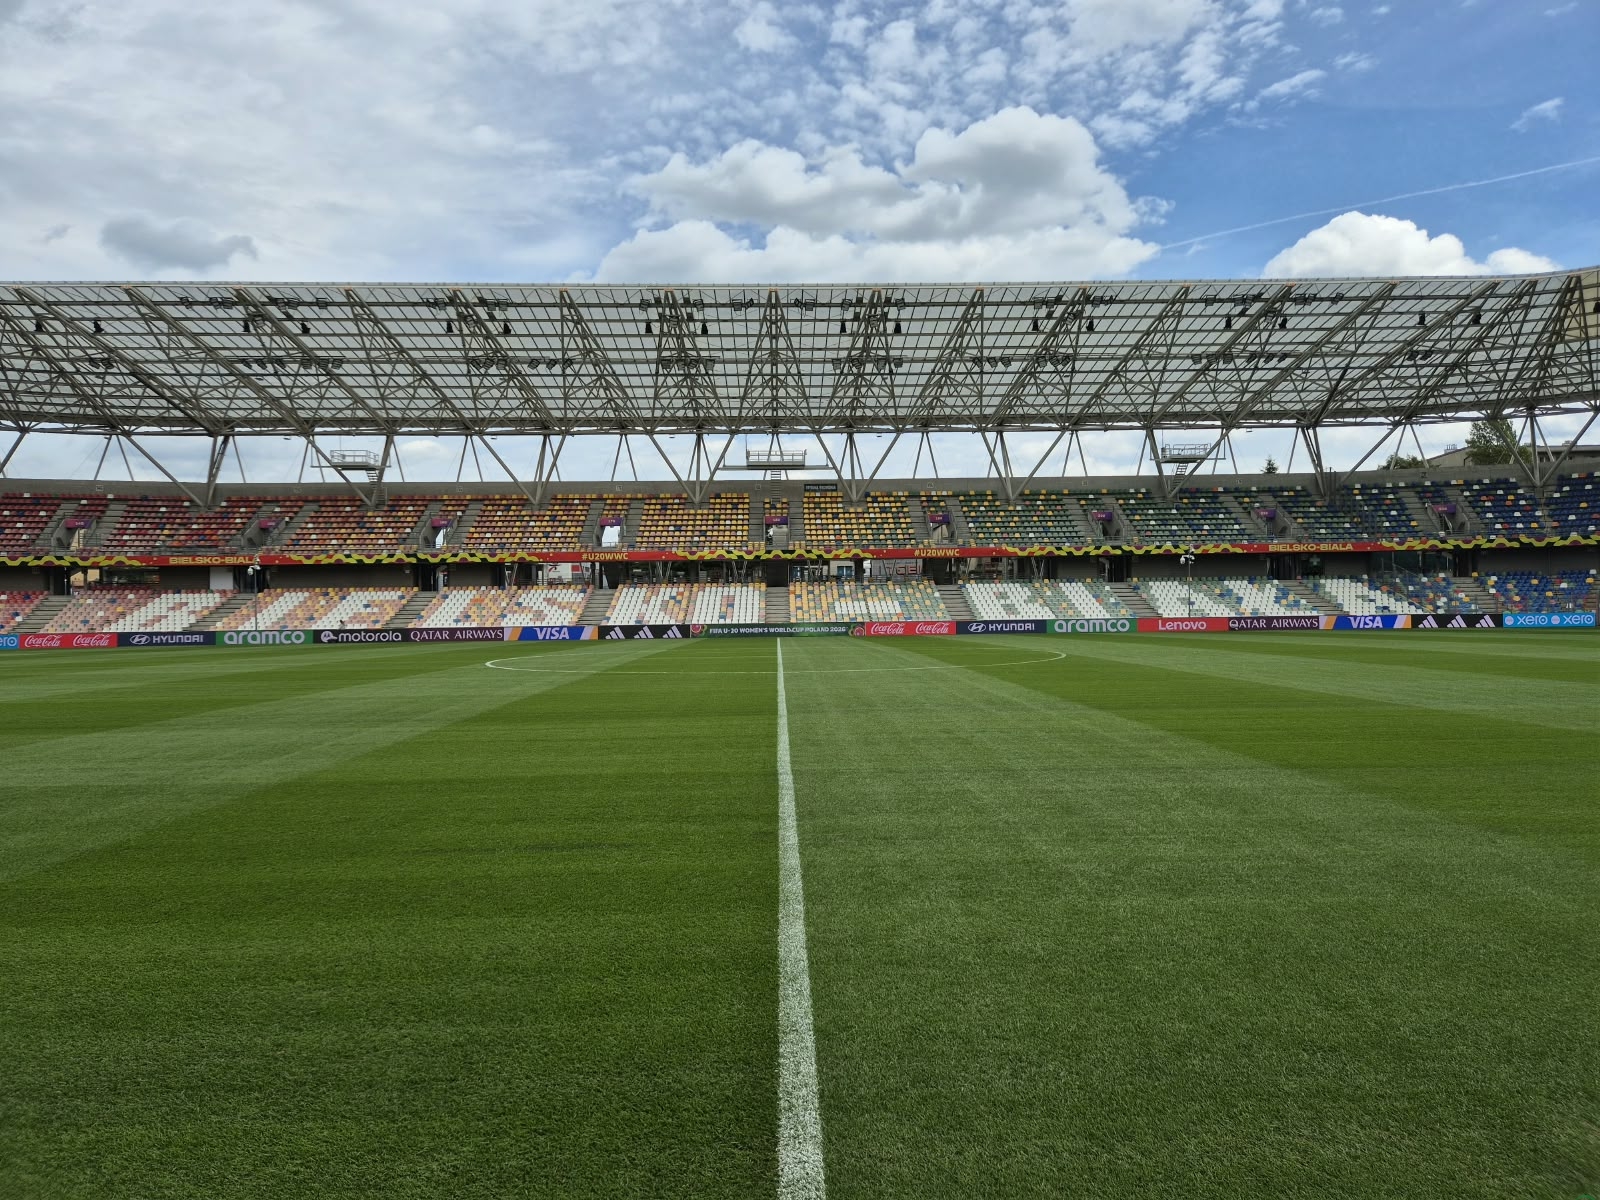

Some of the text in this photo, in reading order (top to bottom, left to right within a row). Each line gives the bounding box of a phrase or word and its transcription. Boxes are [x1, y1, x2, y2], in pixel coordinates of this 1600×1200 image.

[581, 552, 629, 561] #U20WWC
[914, 549, 960, 557] #U20WWC
[1054, 619, 1130, 633] aramco
[1158, 619, 1207, 631] Lenovo
[1229, 617, 1319, 630] QATAR AIRWAYS
[1347, 616, 1383, 629] VISA
[1517, 614, 1594, 625] xero xero
[870, 622, 949, 635] Coca-Cola Coca-Cola
[988, 622, 1035, 631] HYUNDAI
[152, 634, 204, 644] HYUNDAI
[223, 630, 306, 645] aramco
[338, 630, 402, 642] motorola
[410, 629, 503, 642] QATAR AIRWAYS
[533, 627, 570, 640] VISA
[24, 633, 110, 648] Coca-Cola Coca-Cola
